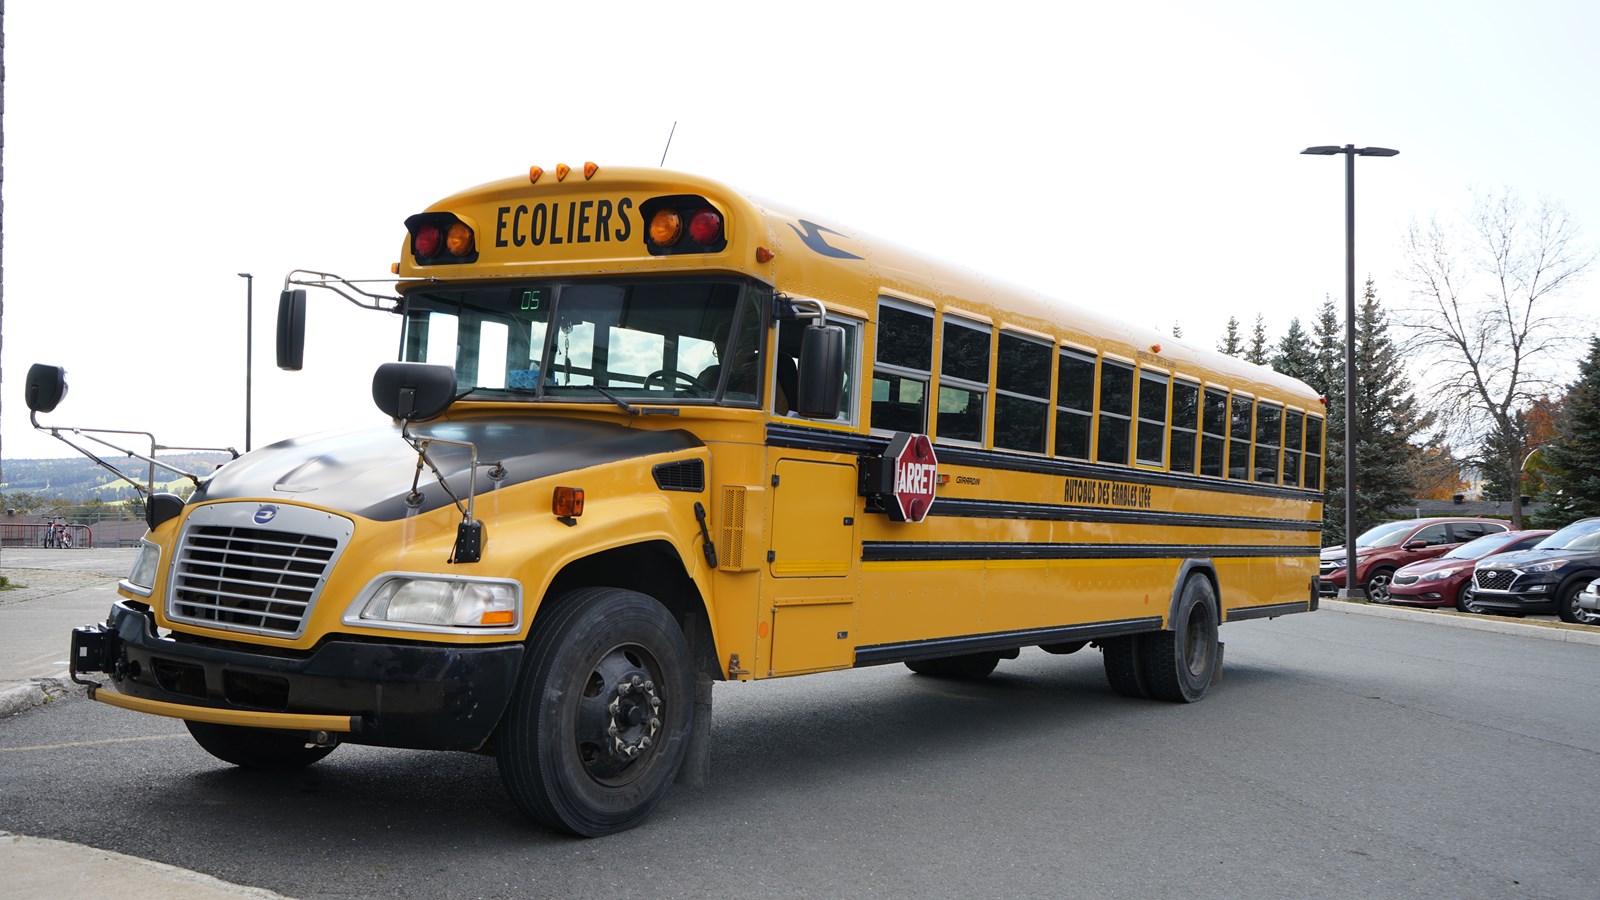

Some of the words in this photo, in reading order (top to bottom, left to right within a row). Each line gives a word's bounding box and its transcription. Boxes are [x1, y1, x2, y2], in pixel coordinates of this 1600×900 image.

[495, 197, 633, 248] ECOLIERS
[521, 290, 540, 310] 05
[898, 462, 936, 495] ARRET
[956, 476, 981, 486] GIRARDIN
[1064, 478, 1096, 503] AUTOBUS
[1097, 482, 1110, 504] DES
[1112, 481, 1137, 506] ÉRABLES
